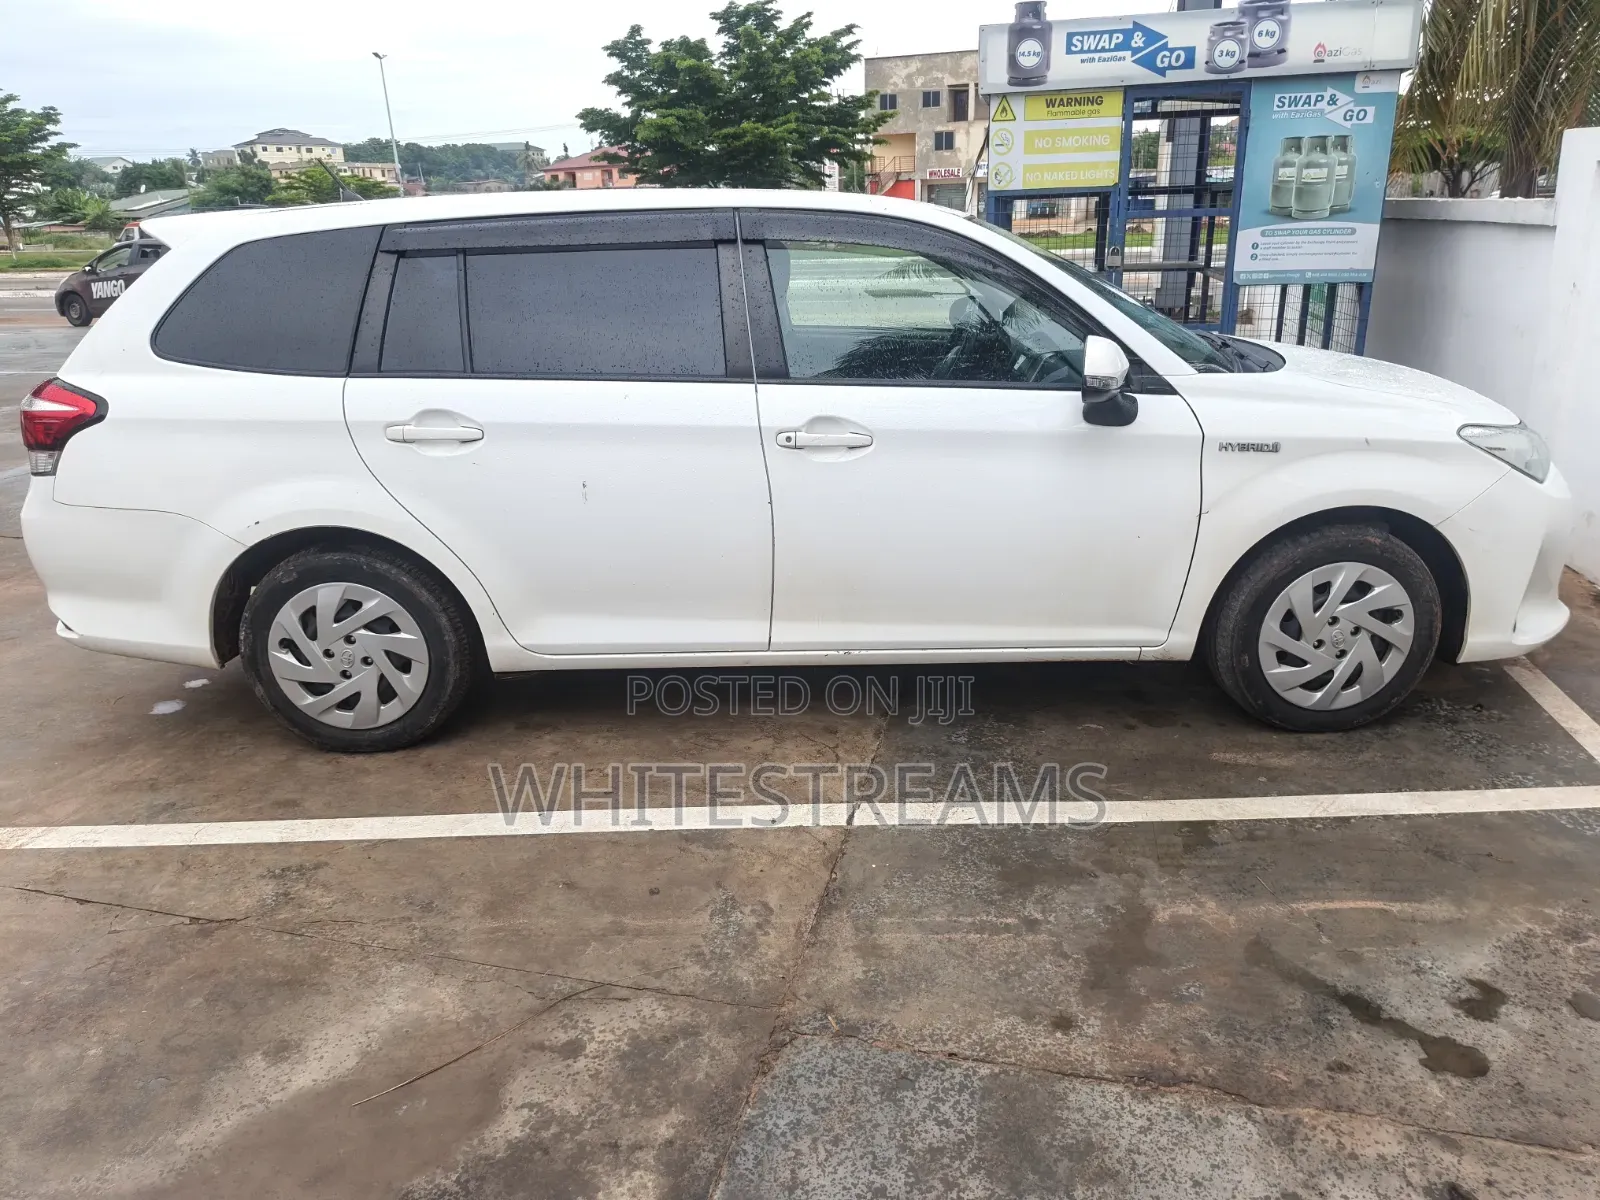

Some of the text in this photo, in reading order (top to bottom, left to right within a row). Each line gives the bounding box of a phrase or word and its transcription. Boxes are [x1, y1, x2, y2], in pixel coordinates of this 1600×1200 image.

[1257, 28, 1276, 39] 6 kg
[1071, 31, 1146, 52] SWAP &
[1018, 50, 1041, 59] 14.5 kg
[1080, 55, 1126, 64] with EaziGas
[1156, 50, 1185, 68] GO
[1217, 49, 1236, 59] 3 kg
[1045, 95, 1104, 109] WARNING
[1276, 93, 1340, 109] SWAP &
[1046, 108, 1101, 118] Flammable gas
[1272, 110, 1321, 119] with EaziGas
[1343, 108, 1368, 122] GO
[1034, 135, 1110, 149] NO SMOKING
[1026, 169, 1116, 183] NO NAKED LIGHTS
[91, 279, 125, 299] YANGO
[1218, 441, 1271, 453] HYBRID
